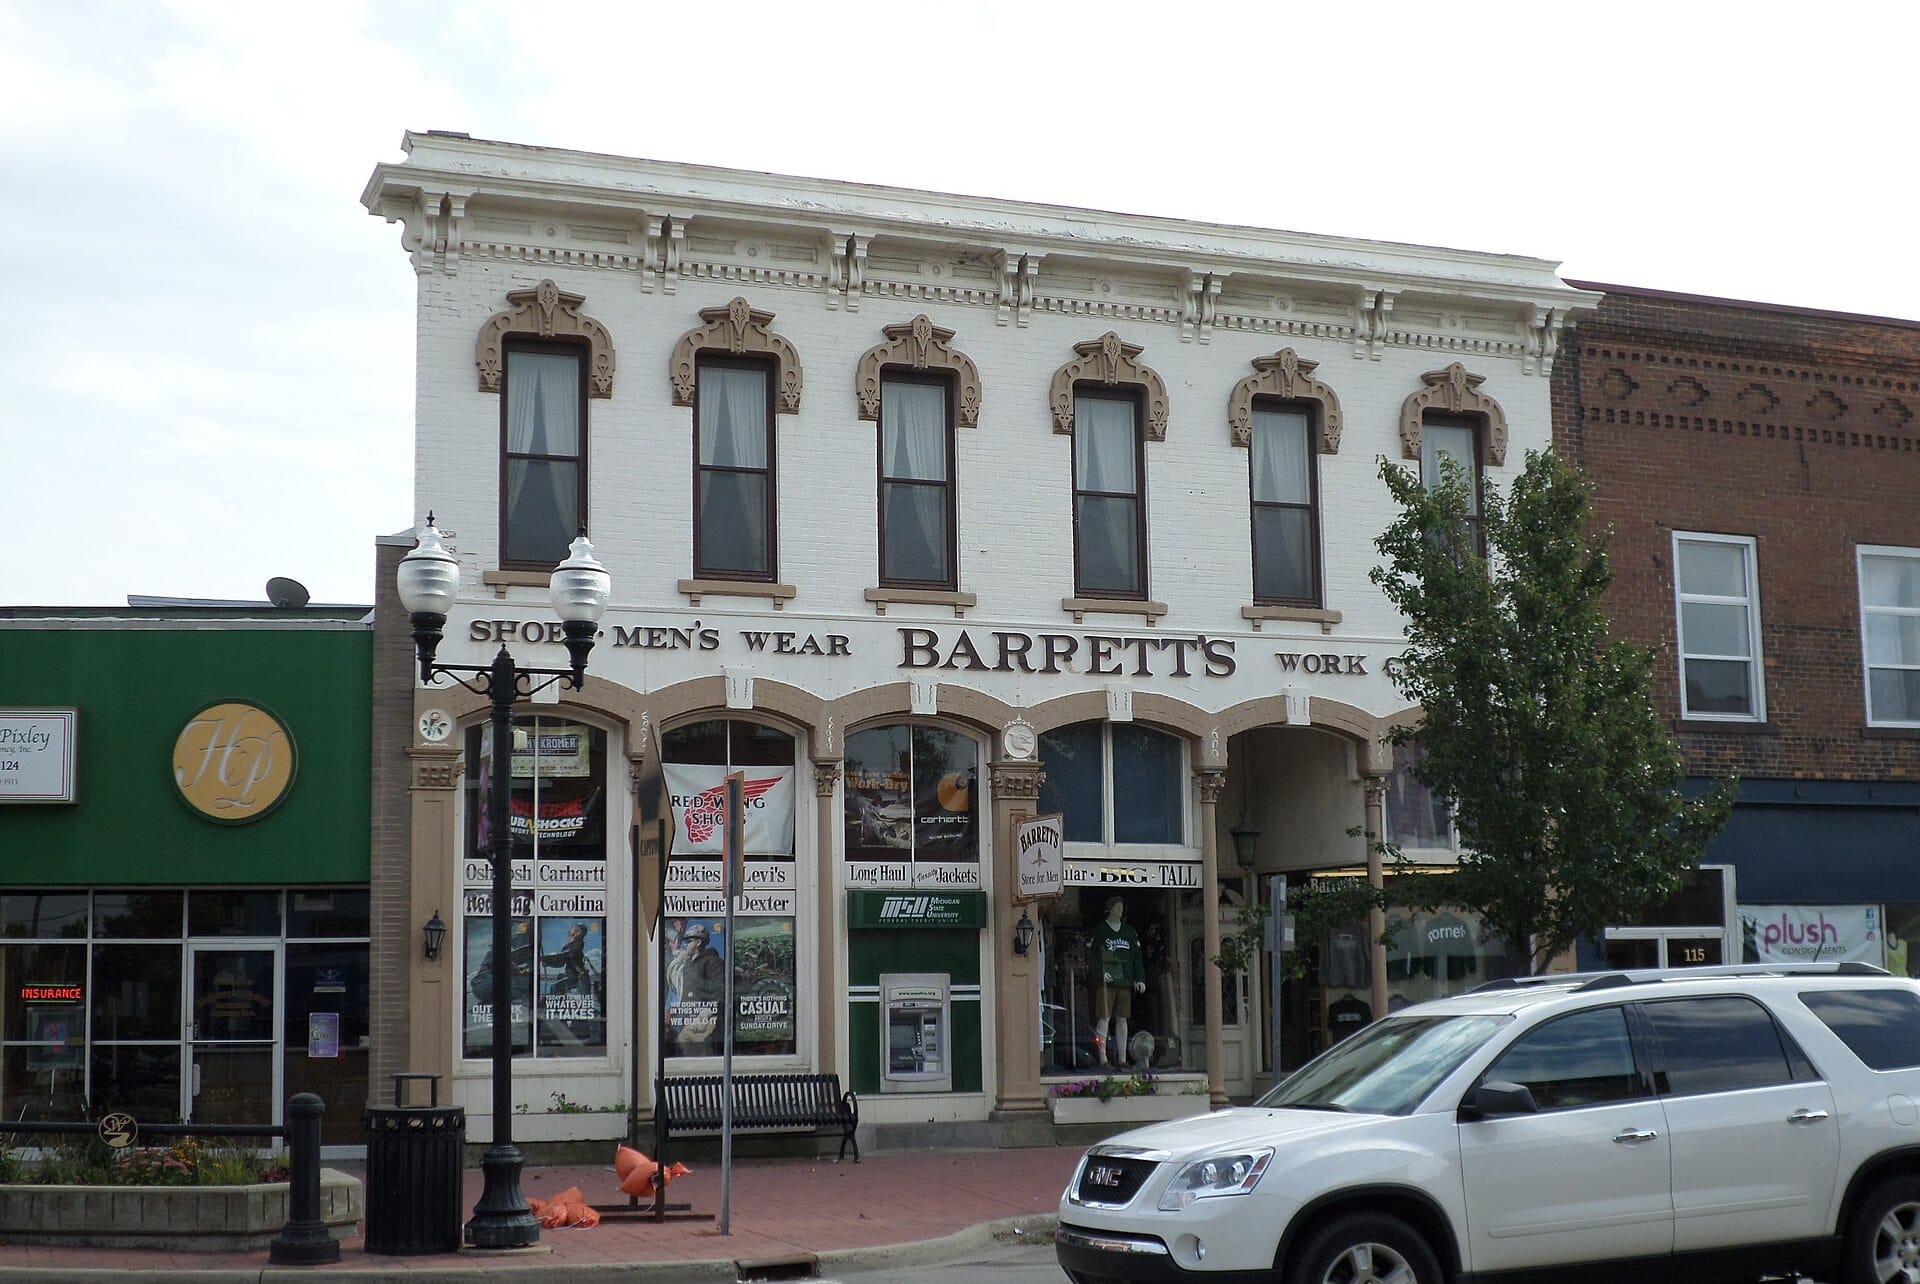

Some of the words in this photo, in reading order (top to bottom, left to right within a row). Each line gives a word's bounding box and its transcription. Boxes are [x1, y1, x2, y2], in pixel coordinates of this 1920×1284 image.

[469, 620, 572, 643] SHOE
[612, 620, 720, 650] MEN'S
[740, 631, 853, 656] WEAR
[897, 627, 1236, 678] BARRETT'S
[1275, 652, 1368, 675] WORK
[541, 738, 576, 749] KROMER
[671, 795, 704, 808] RED
[713, 796, 765, 809] WNG
[510, 816, 584, 830] URASHOCKS
[466, 864, 531, 881] Oshosh
[540, 864, 605, 881] Carhartt
[668, 866, 720, 882] Dickies
[743, 866, 785, 882] Levi's
[850, 865, 877, 884] Long
[880, 865, 906, 881] Haul
[936, 868, 977, 883] Jackets
[1021, 873, 1036, 886] Store
[1047, 871, 1059, 883] Men
[1099, 867, 1148, 884] BIG
[1158, 865, 1197, 886] TALL
[540, 895, 604, 912] Carolina
[664, 896, 726, 912] Wolverine
[738, 895, 790, 912] Dexter
[1764, 913, 1837, 953] plush
[1684, 948, 1706, 962] 115
[22, 988, 82, 999] INSURANCE
[545, 1000, 594, 1009] WHATEVER
[740, 1001, 788, 1015] CASUAL
[545, 1009, 555, 1020] IT
[558, 1009, 595, 1020] TAKES
[670, 1017, 683, 1026] WE
[740, 1022, 766, 1030] SUNDAY
[767, 1021, 788, 1029] DRIVE
[1090, 1167, 1121, 1187] GMC
